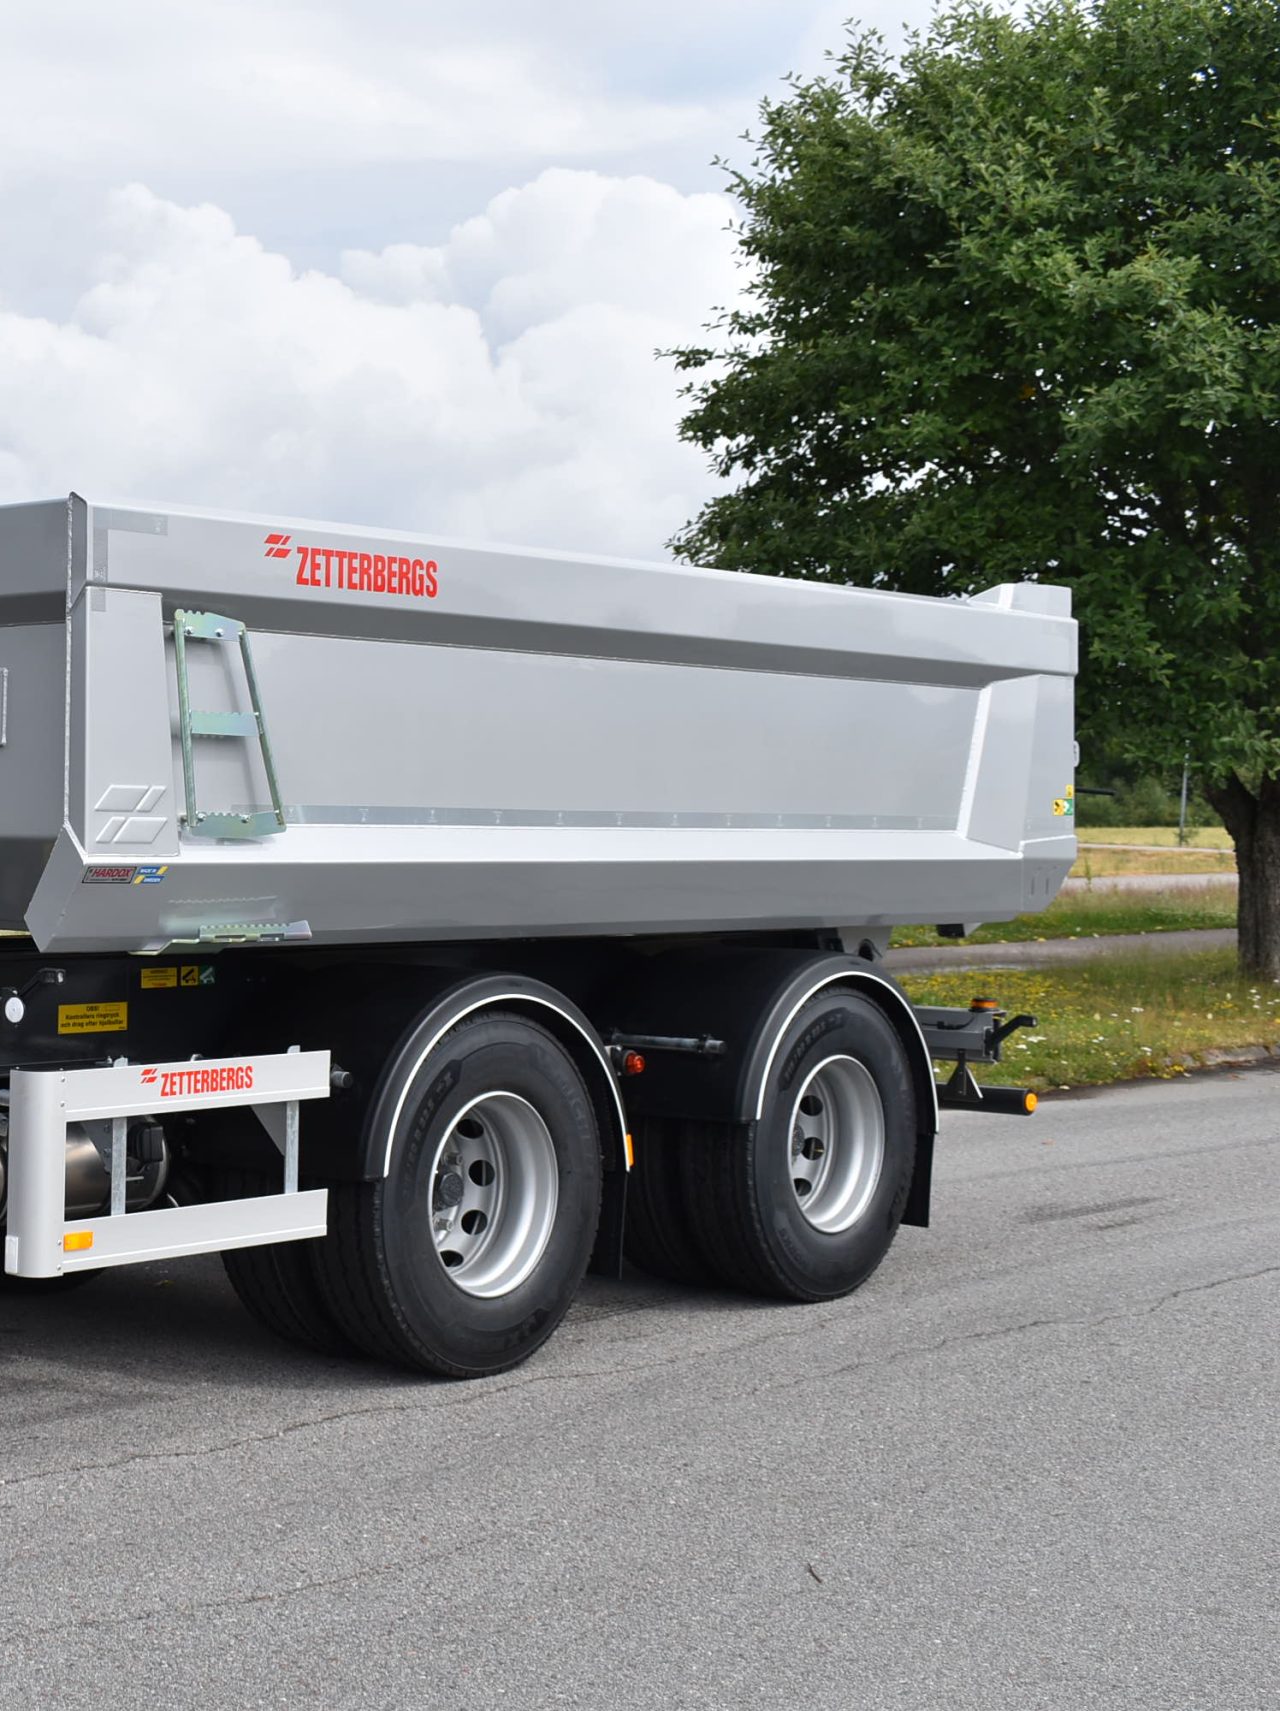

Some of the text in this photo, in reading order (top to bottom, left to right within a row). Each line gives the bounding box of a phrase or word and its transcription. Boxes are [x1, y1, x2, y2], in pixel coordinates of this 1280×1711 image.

[296, 547, 438, 598] ZETTERBERGS
[91, 868, 132, 877] HARDOX
[160, 1065, 253, 1097] ZETTERBERGS
